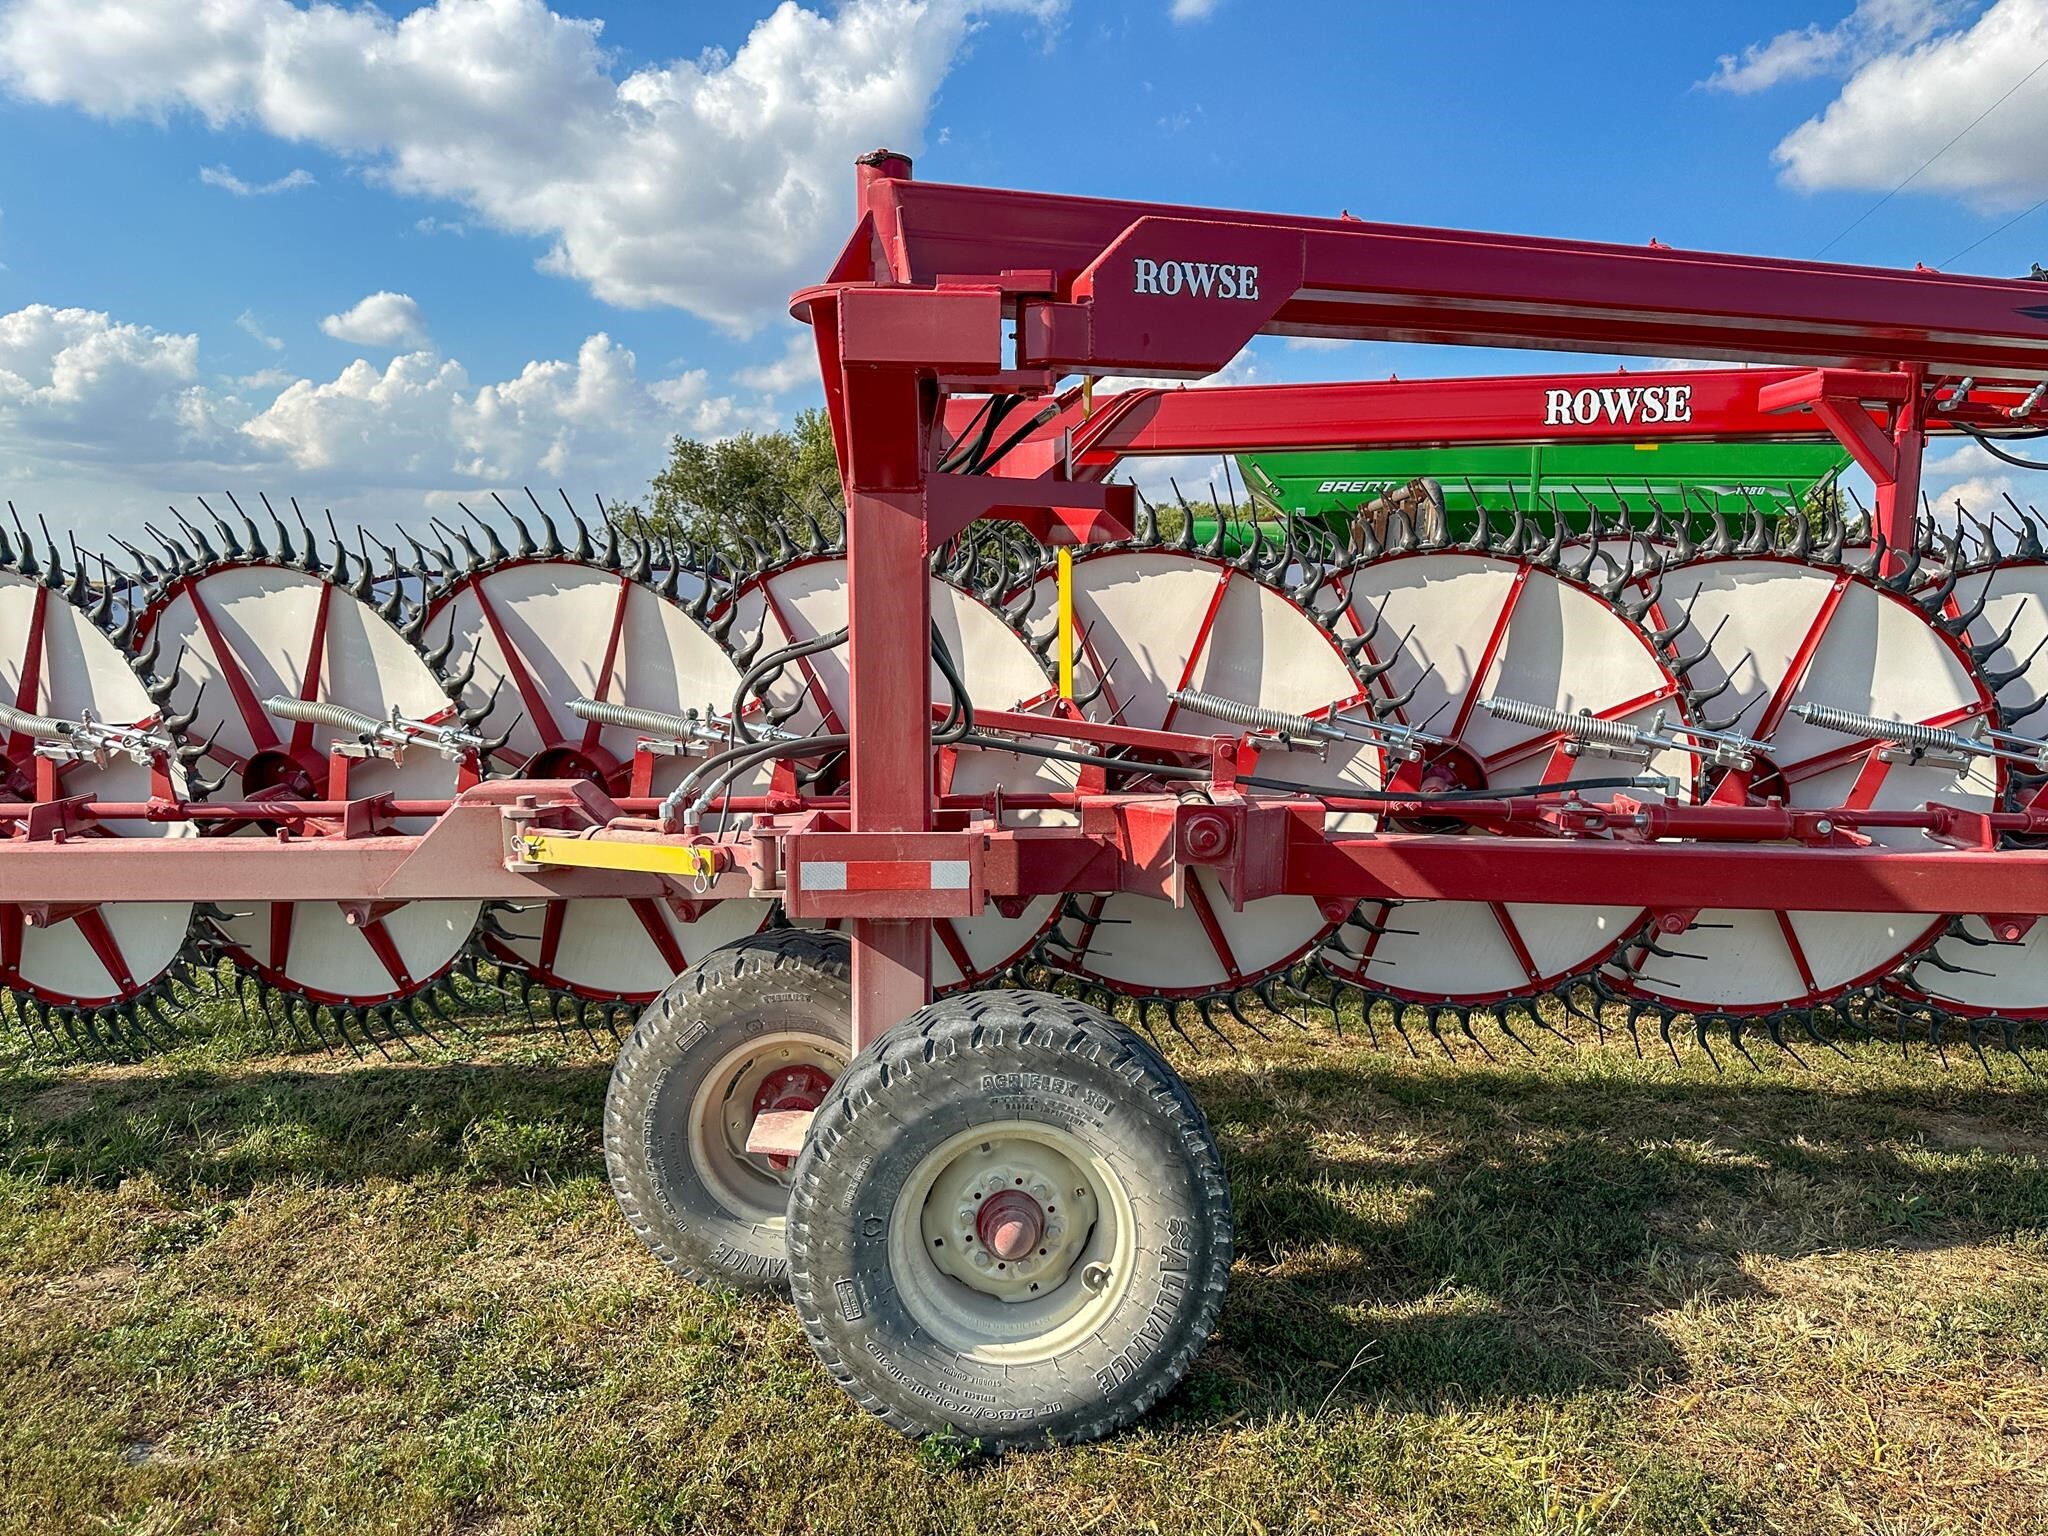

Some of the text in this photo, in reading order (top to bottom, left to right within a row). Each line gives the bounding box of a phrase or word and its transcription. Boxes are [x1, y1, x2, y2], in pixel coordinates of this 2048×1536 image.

[1133, 257, 1259, 301] ROWSE
[1543, 384, 1692, 426] ROWSE
[1317, 481, 1397, 493] BRENT
[709, 1241, 789, 1278] ANCE
[1095, 1244, 1190, 1394] ALLIANCE
